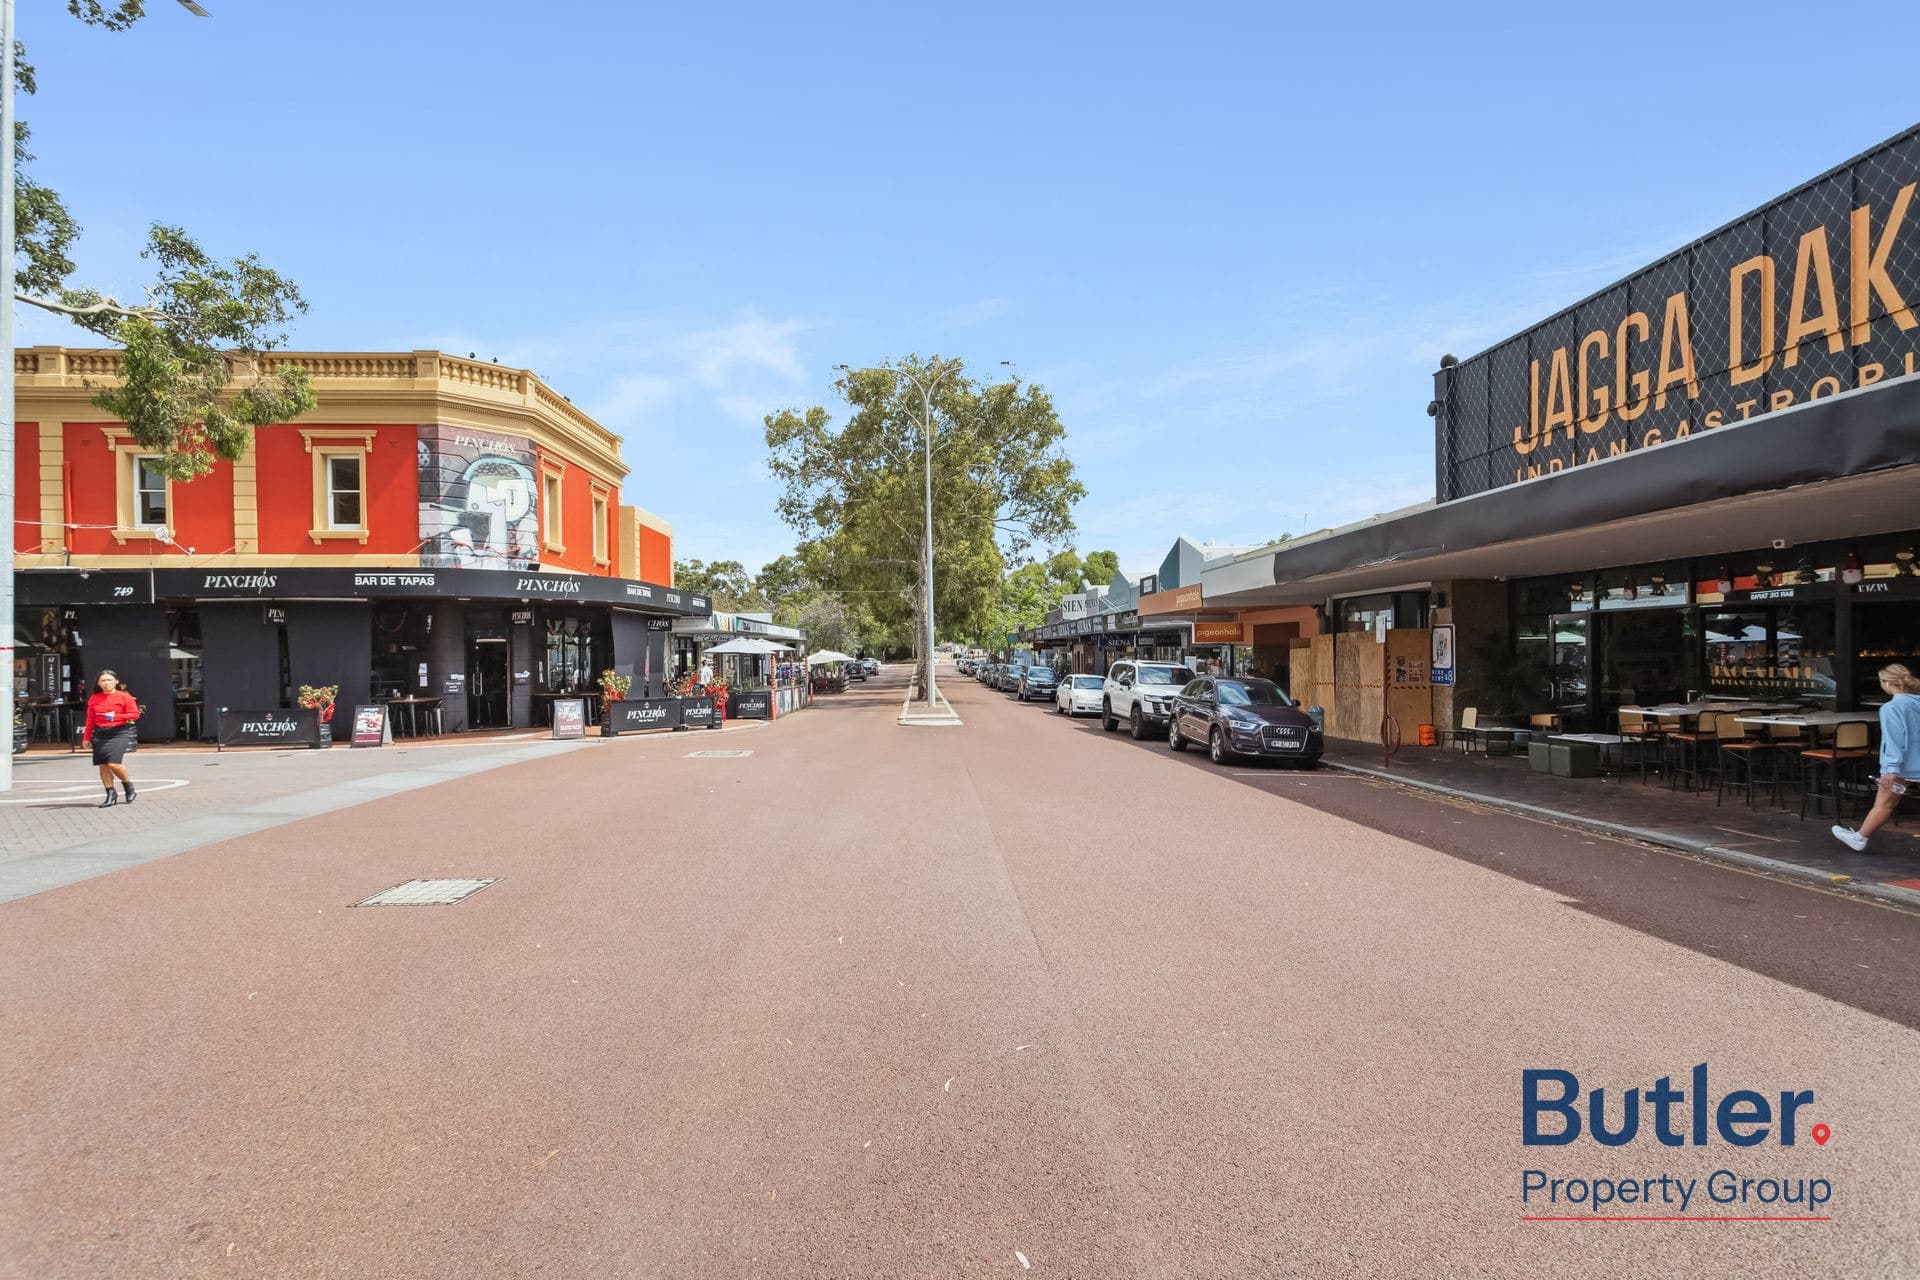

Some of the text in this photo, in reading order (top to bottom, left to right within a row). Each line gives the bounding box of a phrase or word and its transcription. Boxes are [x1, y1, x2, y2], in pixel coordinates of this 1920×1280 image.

[1513, 182, 1919, 455] JAGGA DAK
[1516, 438, 1627, 483] INDIAN
[113, 585, 134, 597] 749
[203, 571, 278, 592] PINCHOS
[354, 576, 435, 586] BAR DE TAPAS
[515, 577, 581, 597] PINCHOS
[241, 719, 297, 735] PINCHOS
